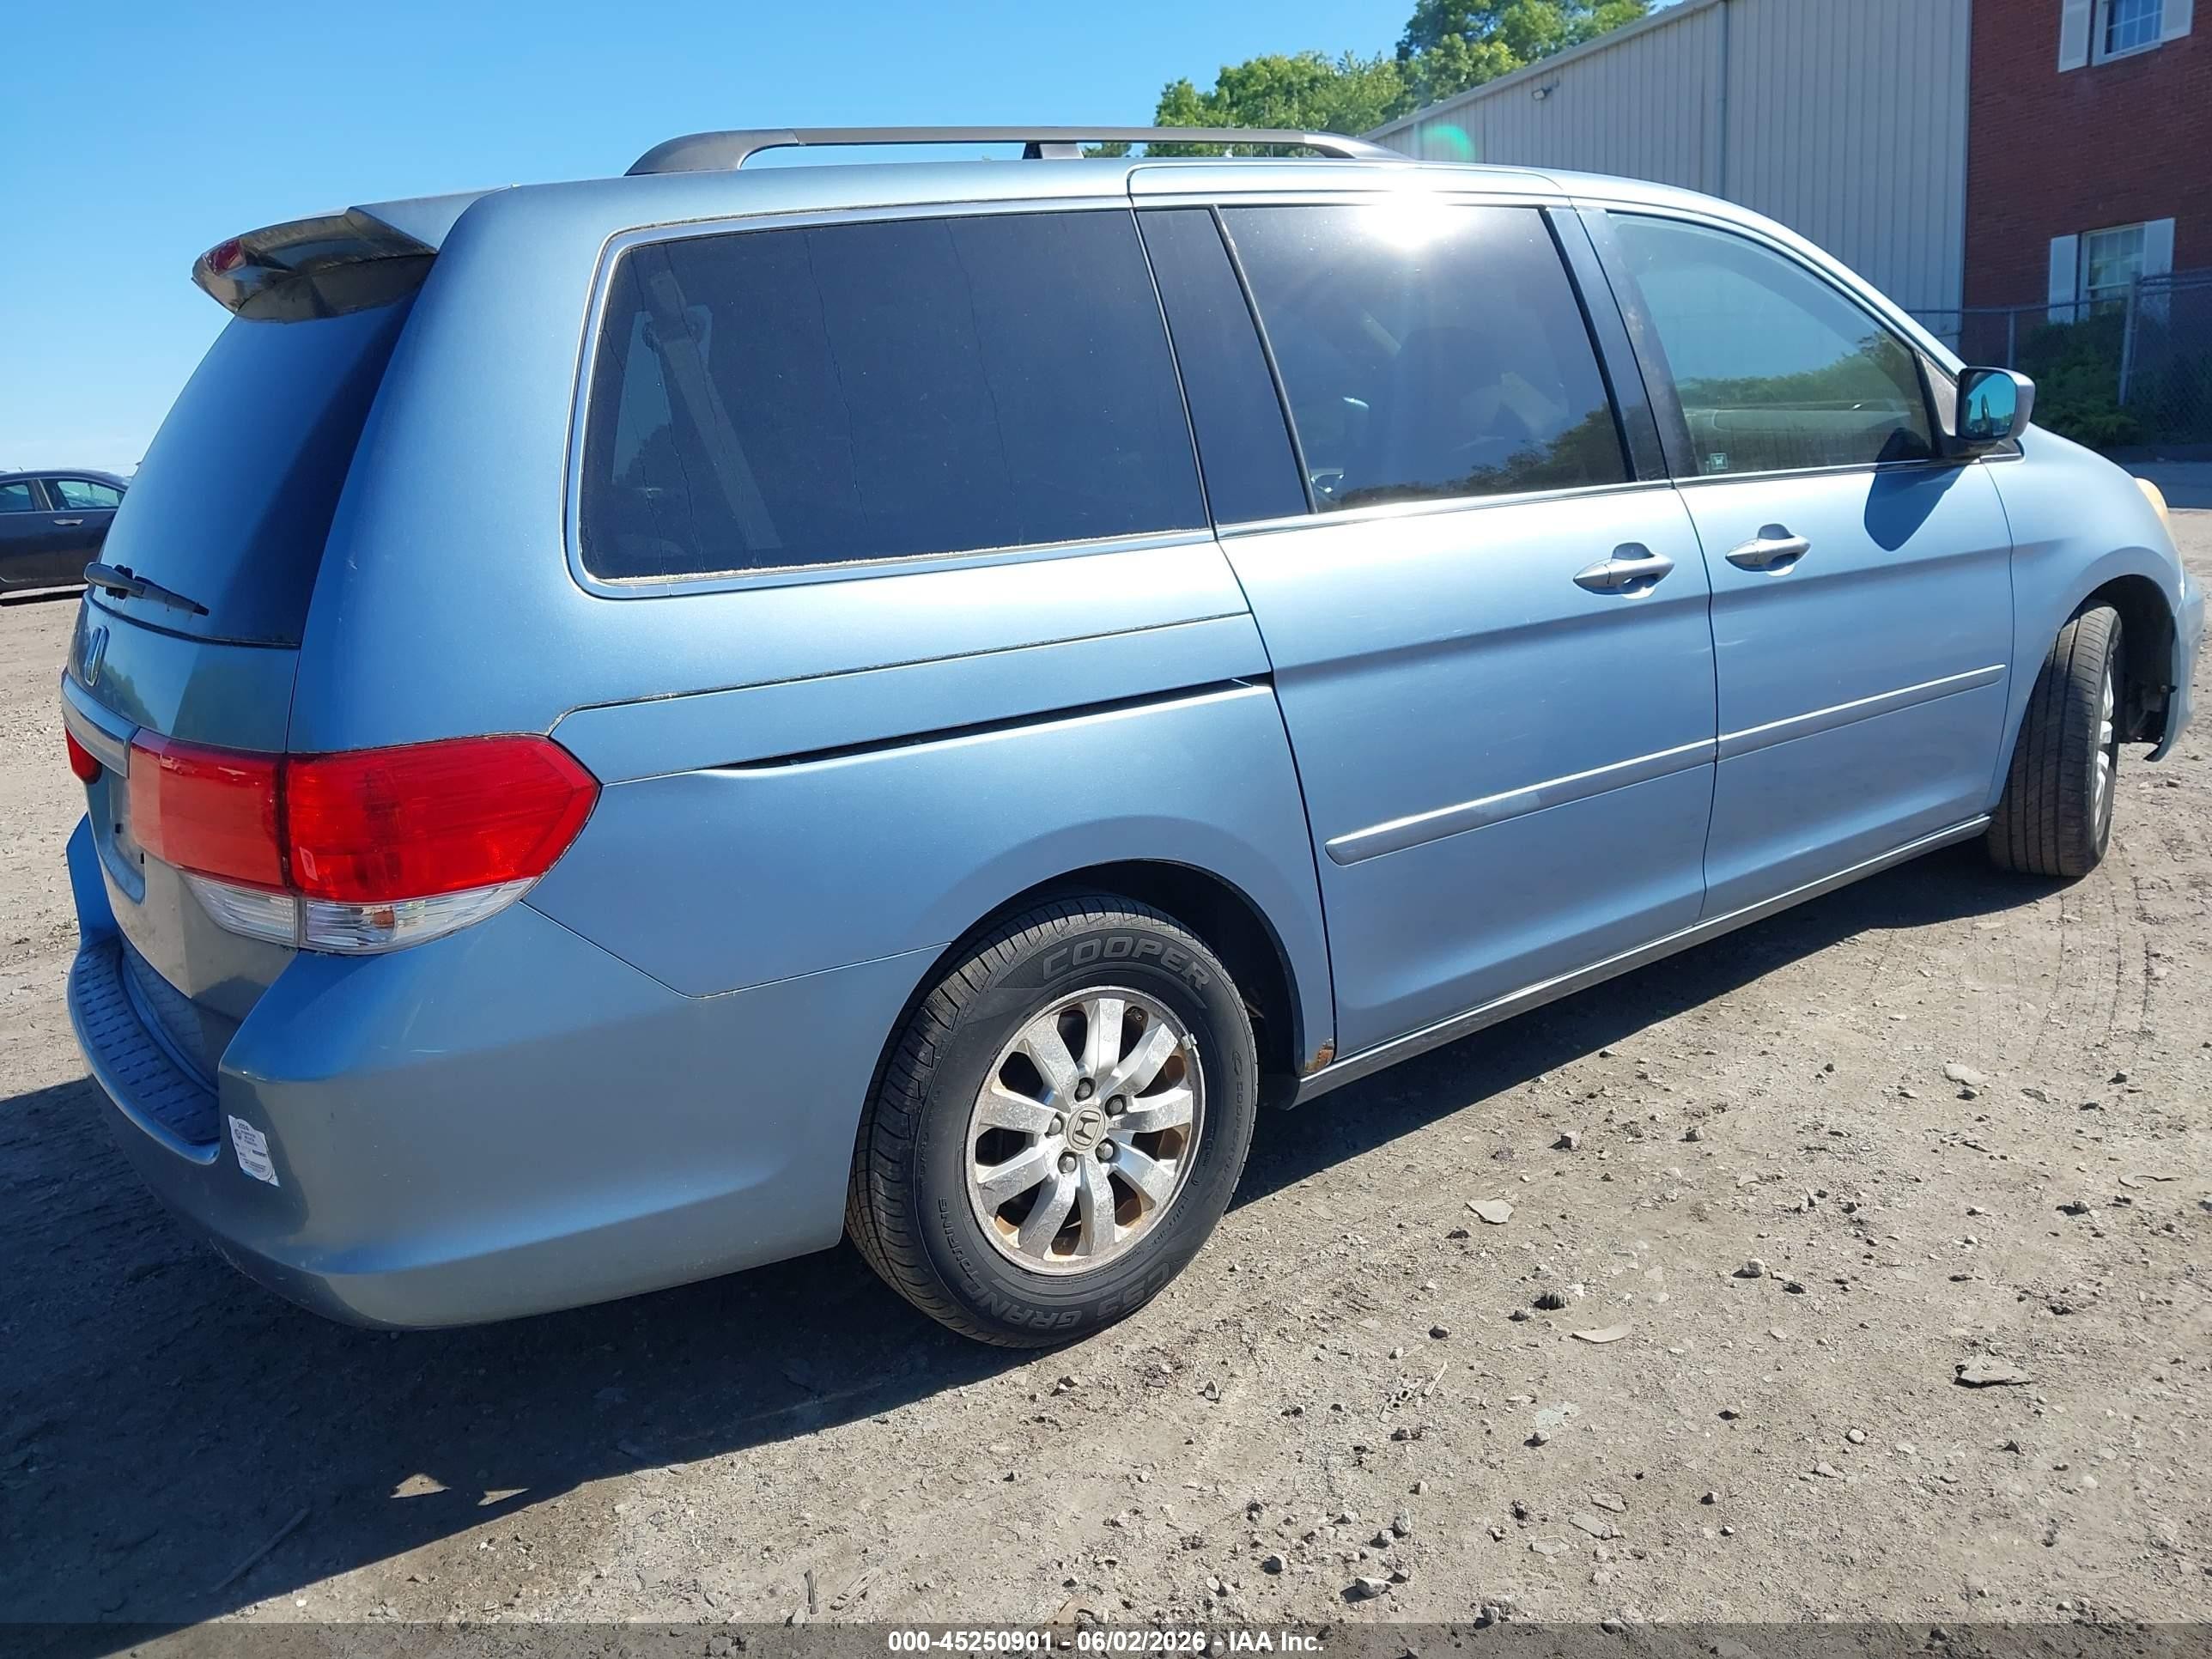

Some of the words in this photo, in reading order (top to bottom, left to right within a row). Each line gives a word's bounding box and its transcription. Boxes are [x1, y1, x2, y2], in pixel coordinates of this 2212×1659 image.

[1042, 936, 1210, 991] COOPER
[939, 1197, 981, 1288] TOURING
[960, 1277, 1082, 1330] GRAND
